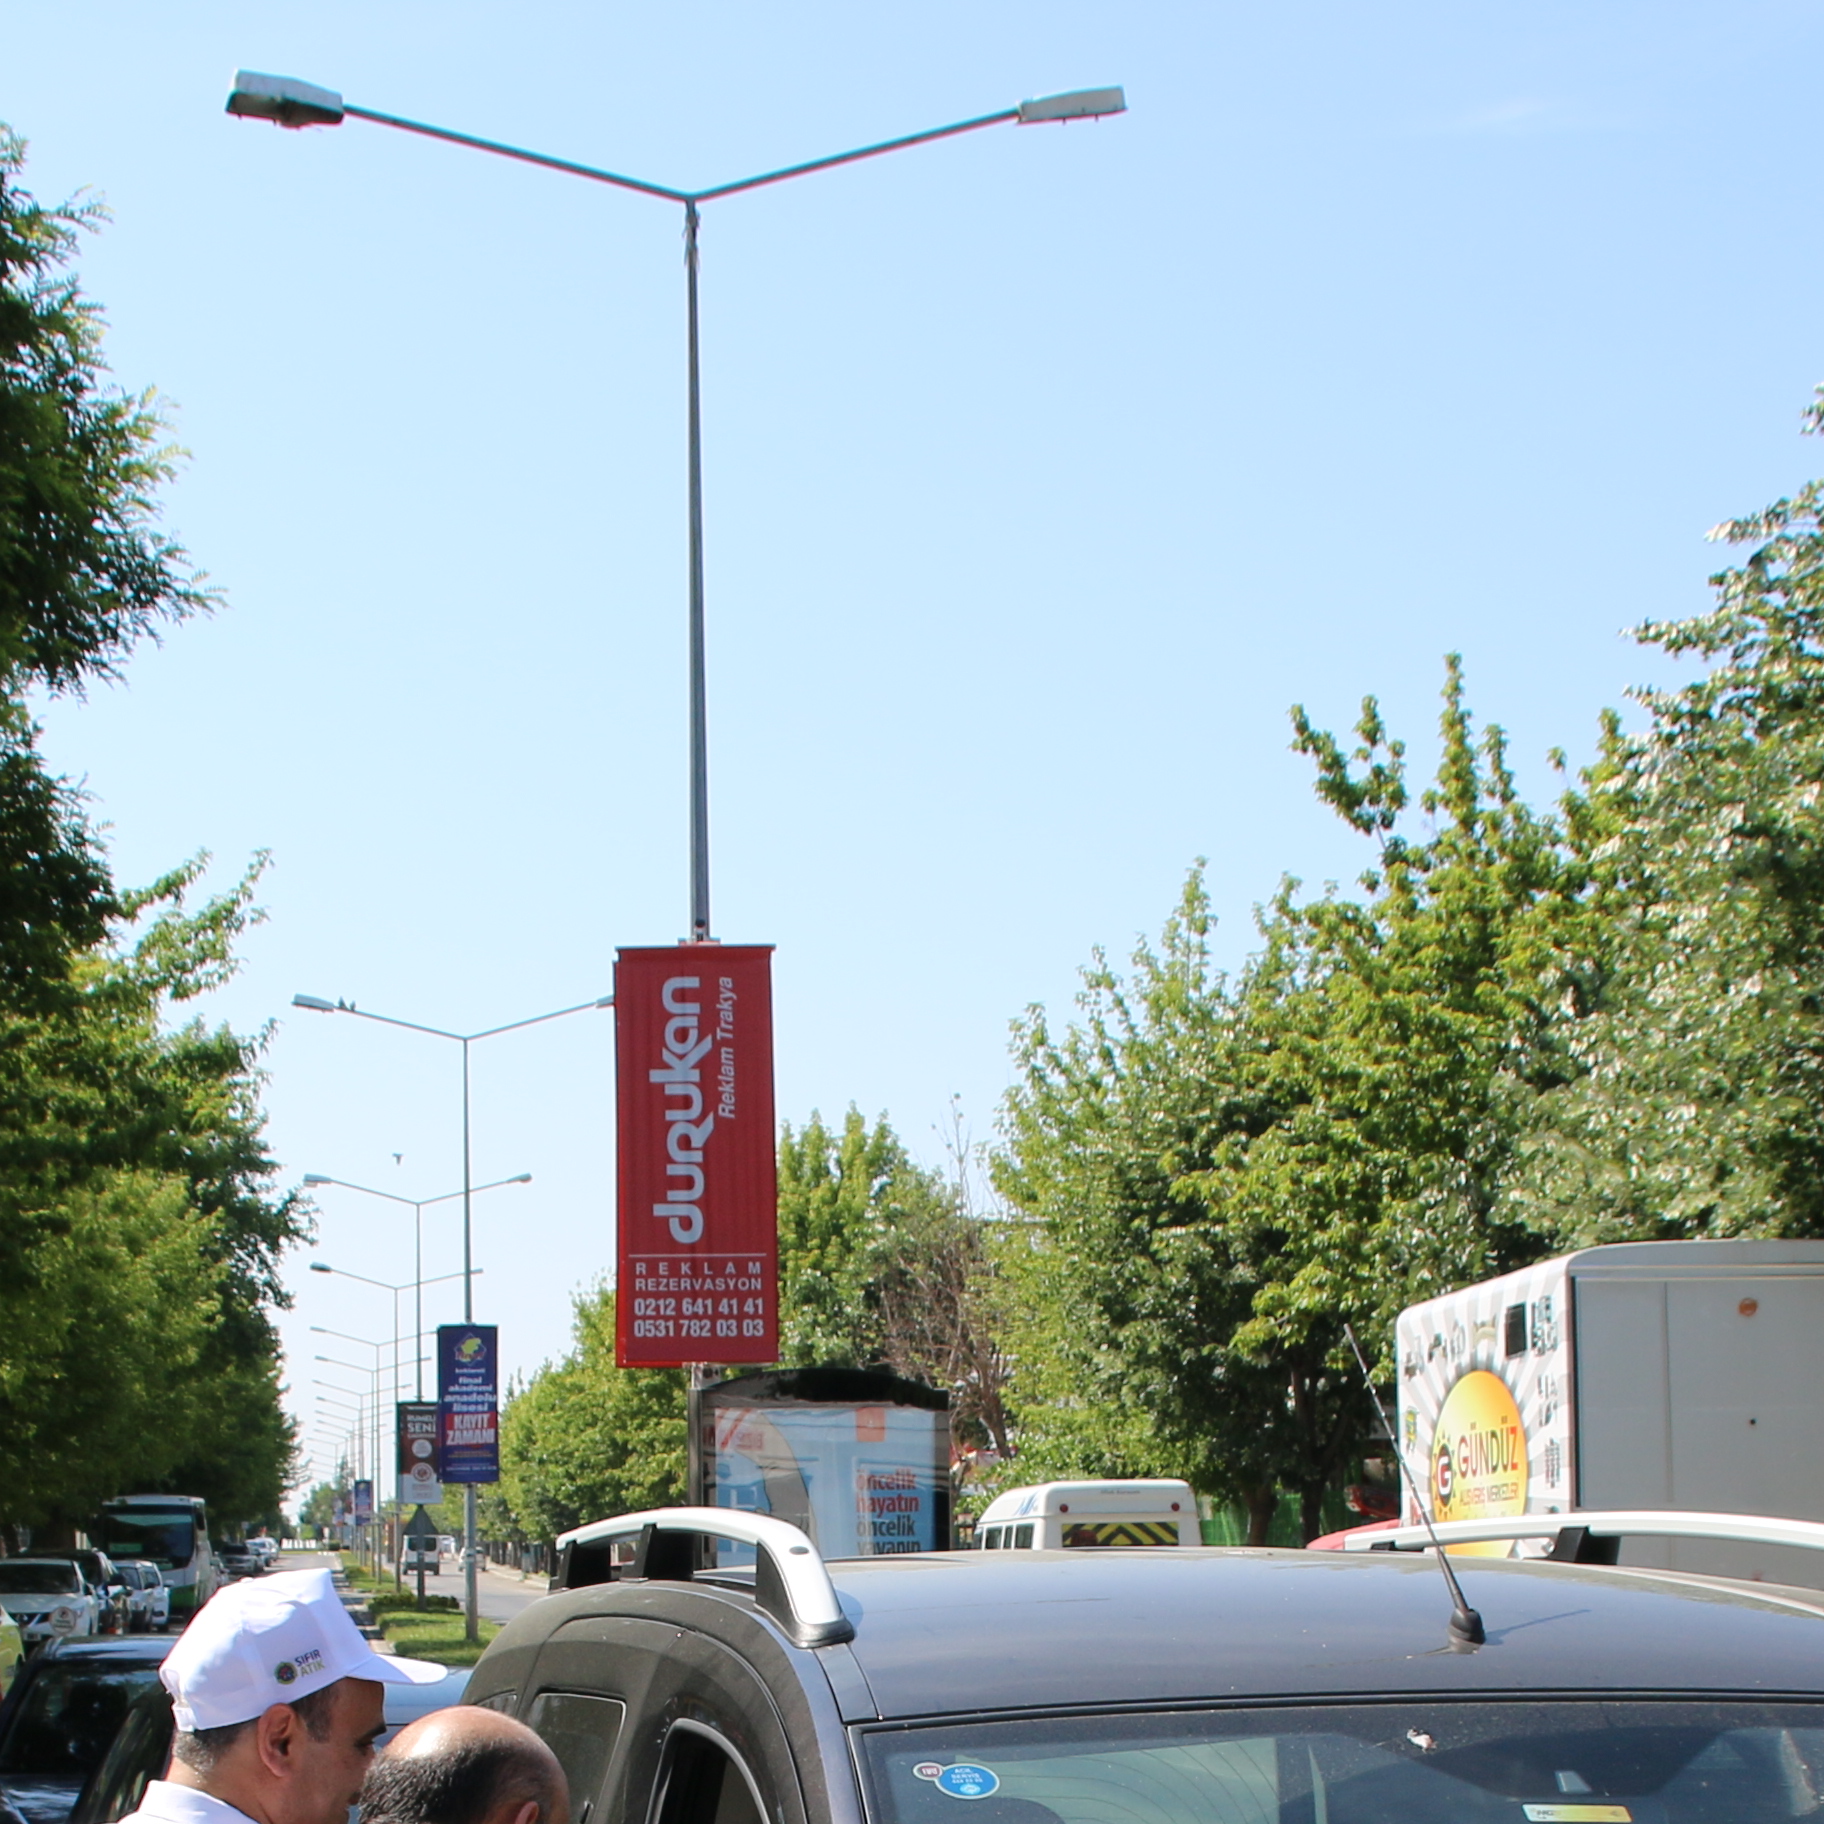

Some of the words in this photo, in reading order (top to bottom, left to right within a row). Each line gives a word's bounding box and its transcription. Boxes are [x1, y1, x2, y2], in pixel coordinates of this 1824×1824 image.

[716, 976, 737, 1041] Trakya
[717, 1047, 736, 1119] Reklam
[635, 1277, 763, 1292] REZERVASYON
[634, 1298, 676, 1317] 0212
[682, 1298, 713, 1316] 641
[718, 1297, 739, 1316] 41
[743, 1297, 764, 1316] 41
[634, 1319, 675, 1338] 0531
[679, 1319, 712, 1338] 782
[716, 1319, 738, 1337] 03
[742, 1318, 764, 1337] 03
[454, 1414, 490, 1429] KAYIT
[446, 1429, 496, 1446] ZAMANI
[1457, 1416, 1519, 1479] GÜNDÜZ
[856, 1469, 917, 1491] öncelik
[856, 1492, 920, 1518] hayatın
[857, 1514, 916, 1537] öncelik
[294, 1649, 321, 1667] SIFIR
[300, 1659, 326, 1677] ATIK
